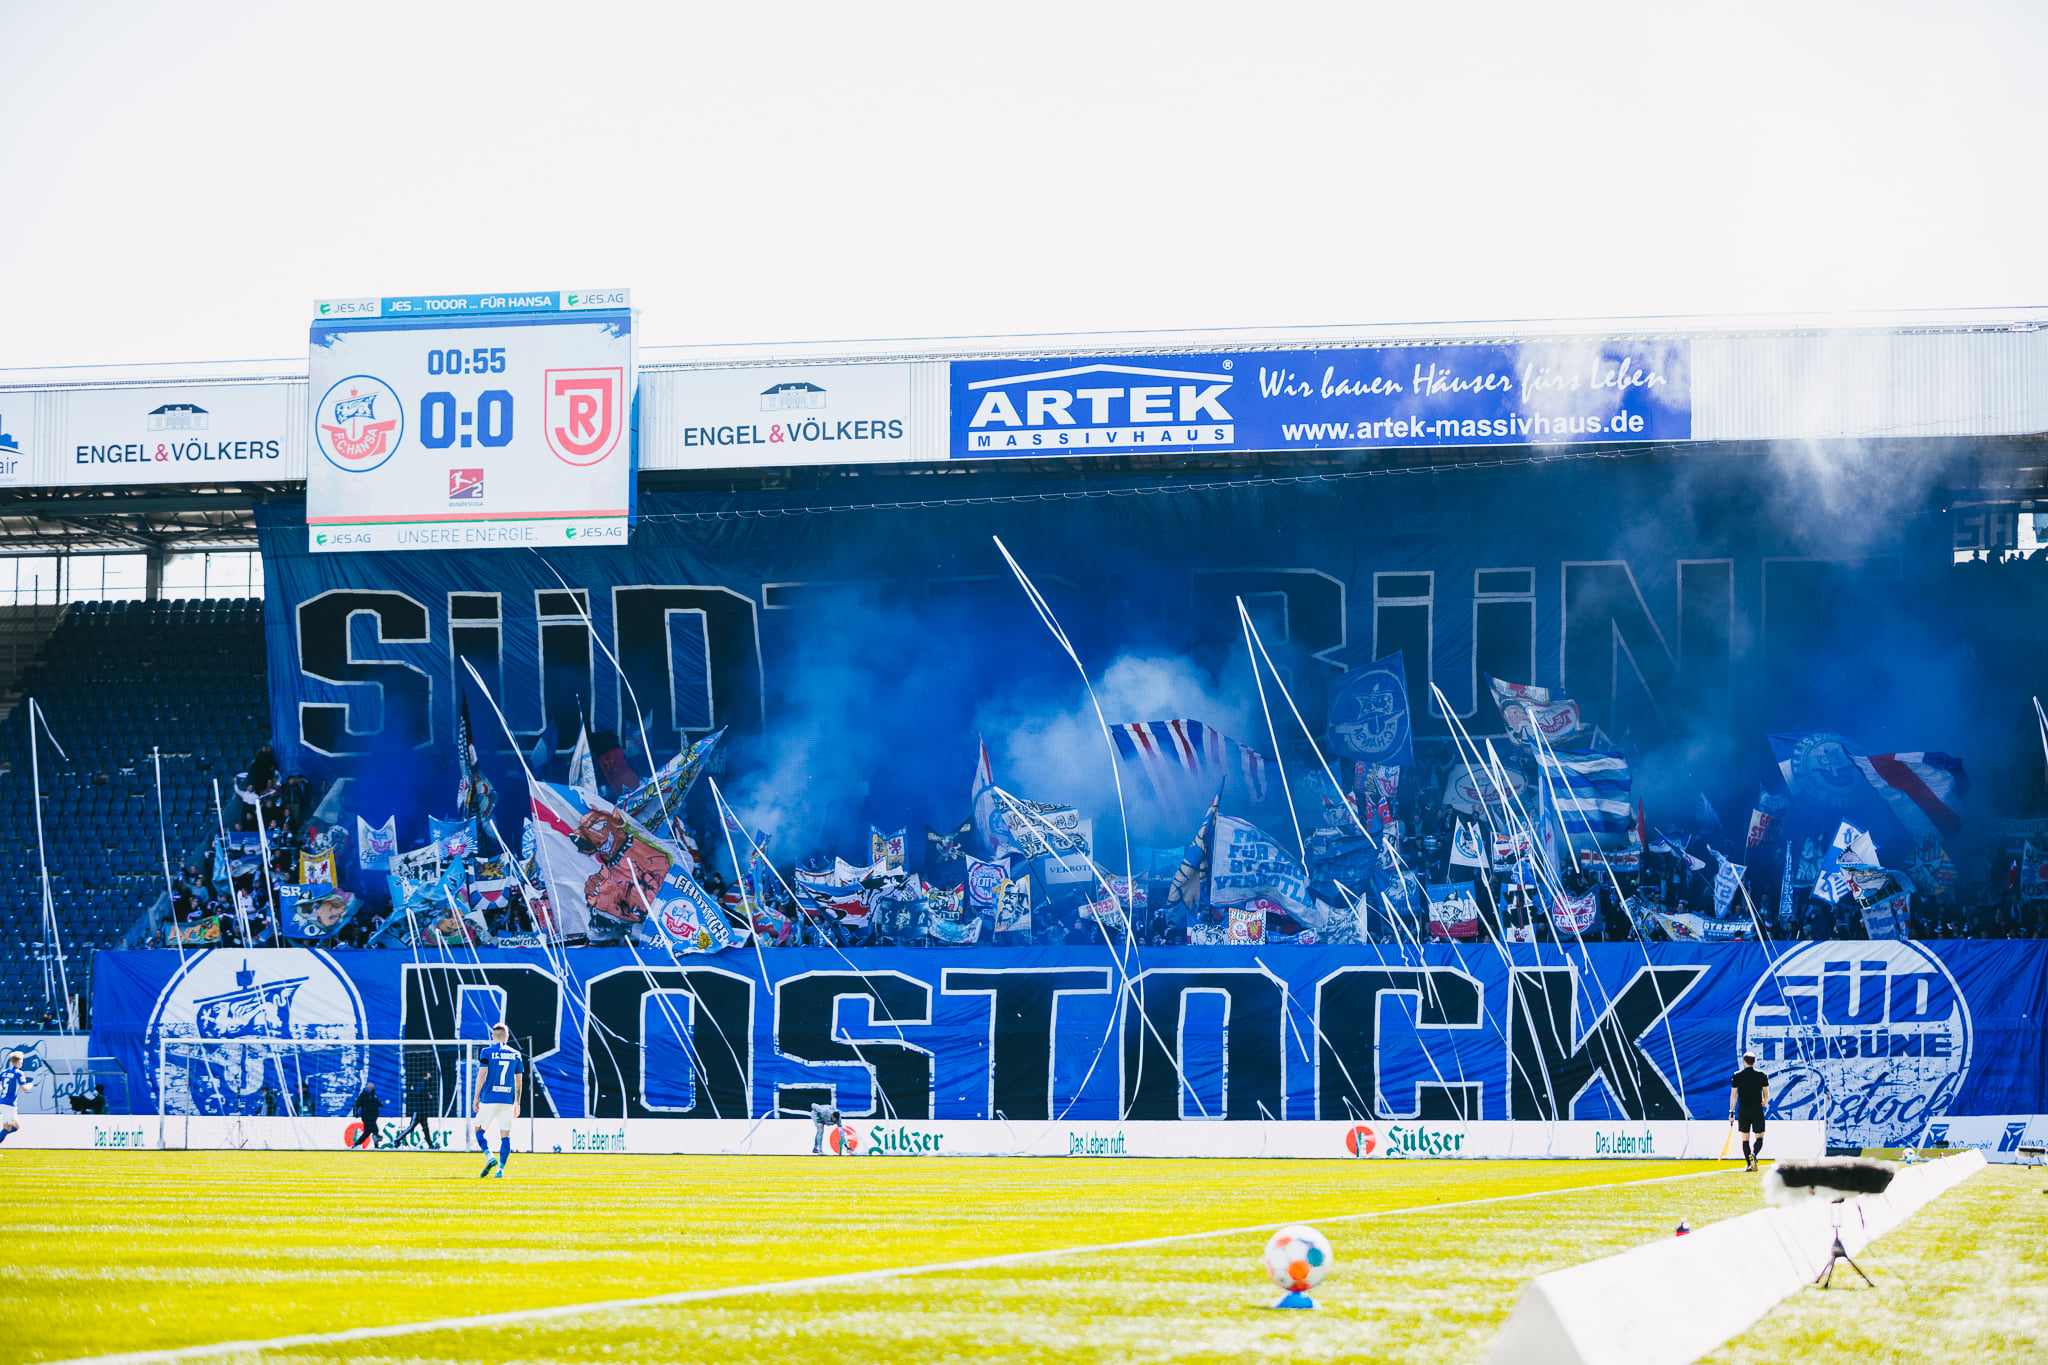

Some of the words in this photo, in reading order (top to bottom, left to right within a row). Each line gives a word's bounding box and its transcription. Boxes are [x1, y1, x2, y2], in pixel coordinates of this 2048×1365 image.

[334, 302, 375, 314] JES.AG
[388, 300, 412, 312] JES
[425, 298, 467, 311] TOOOR
[480, 295, 506, 309] FÜR
[508, 295, 552, 308] HANSA
[581, 293, 624, 305] JES.AG
[427, 347, 506, 376] 00:55
[1258, 366, 1314, 399] Wir
[1321, 365, 1404, 399] bauen
[1412, 363, 1513, 397] Häuser
[1520, 366, 1581, 404] fürs
[1590, 356, 1668, 391] Leben
[968, 384, 1235, 428] ARTEK
[420, 389, 514, 449] 0:0
[1281, 410, 1645, 442] www.artek-massivhaus.de
[977, 428, 1226, 448] MASSIVHAUS
[331, 533, 372, 545] JES.AG
[398, 528, 461, 544] UNSERE
[466, 527, 539, 543] ENERGIE.
[580, 527, 623, 539] JES.AG
[1754, 960, 1954, 1027] SÜD
[401, 962, 1712, 1120] ROSTOCK
[1750, 1030, 1953, 1060] TRIBÜNE
[498, 1060, 510, 1086] 7
[94, 1125, 107, 1147] Das
[109, 1124, 130, 1147] Leben
[572, 1128, 586, 1151] Das
[587, 1127, 610, 1151] Leben
[869, 1124, 944, 1156] Lübzer
[1069, 1131, 1084, 1154] Das
[1086, 1130, 1109, 1154] Leben
[1386, 1123, 1465, 1156] Lübzer
[1595, 1131, 1610, 1154] Das
[1612, 1130, 1636, 1154] Leben
